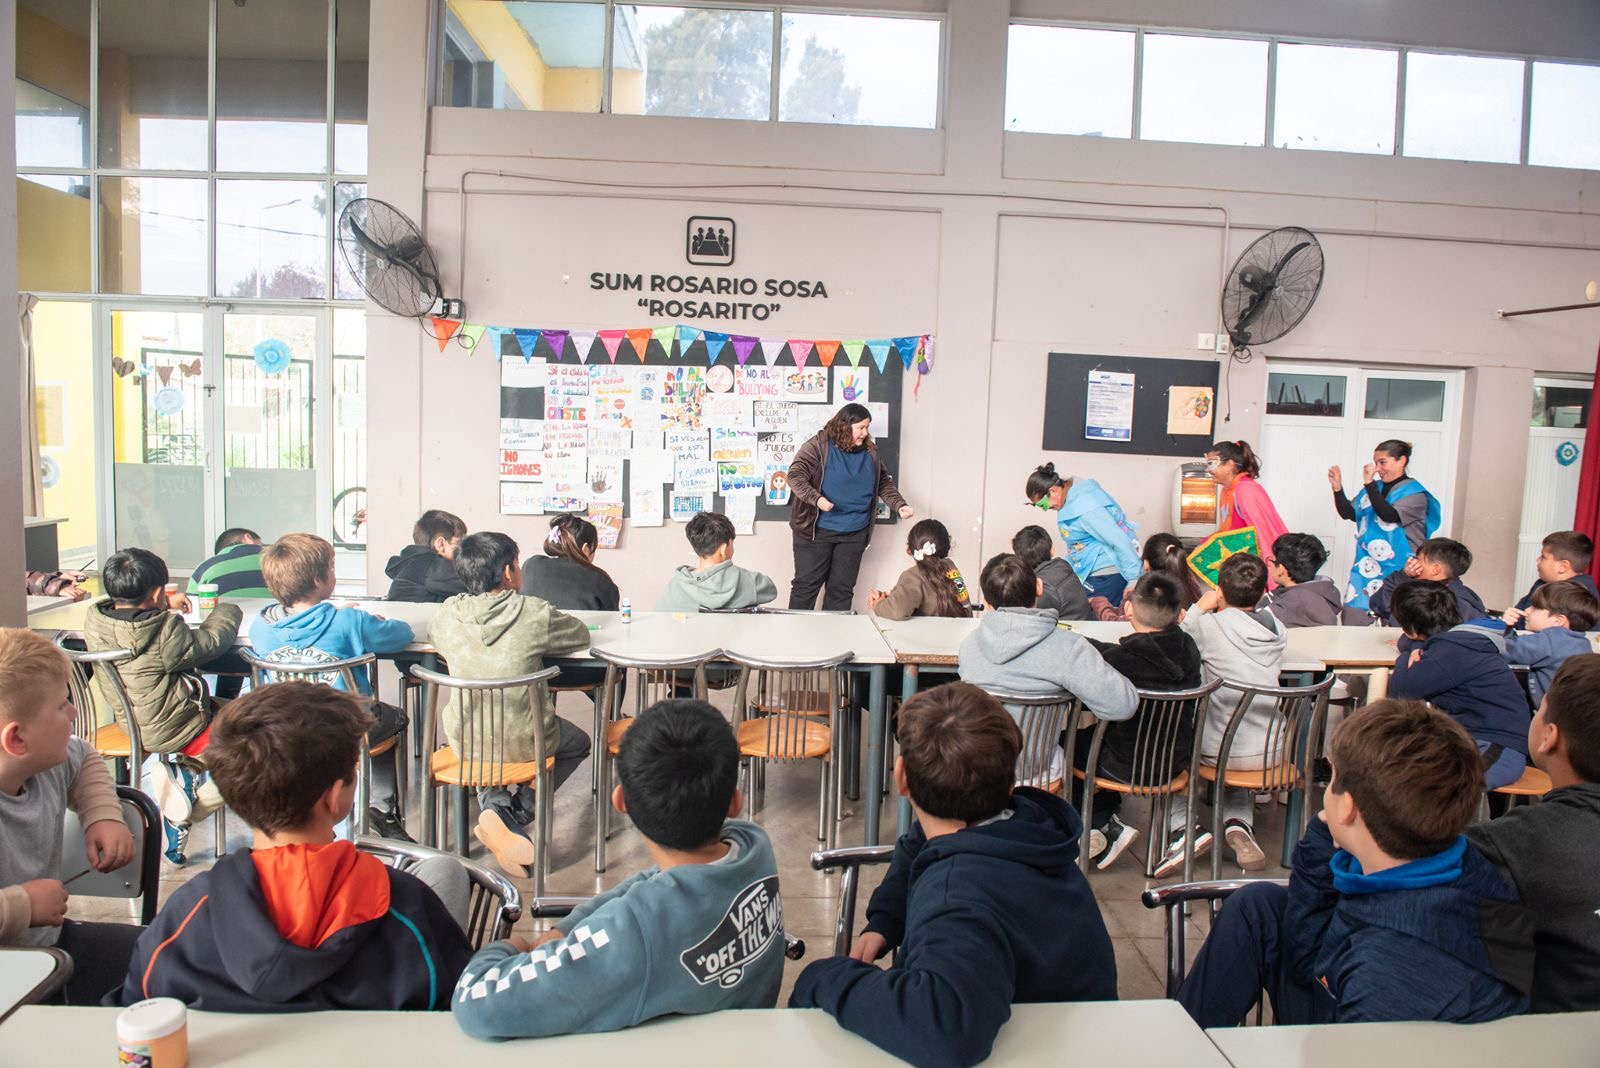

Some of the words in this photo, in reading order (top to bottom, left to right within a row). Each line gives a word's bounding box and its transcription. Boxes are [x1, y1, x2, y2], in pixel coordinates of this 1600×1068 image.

[590, 272, 642, 291] SUM
[650, 274, 758, 295] ROSARIO
[764, 279, 828, 298] SOSA
[637, 298, 781, 321] “ROSARITO”
[746, 369, 757, 378] NO
[760, 370, 770, 379] AL
[738, 383, 778, 396] BULLYING
[504, 450, 518, 462] NO
[500, 463, 542, 476] IGNORES
[729, 882, 770, 932] VANS
[738, 914, 767, 956] THE
